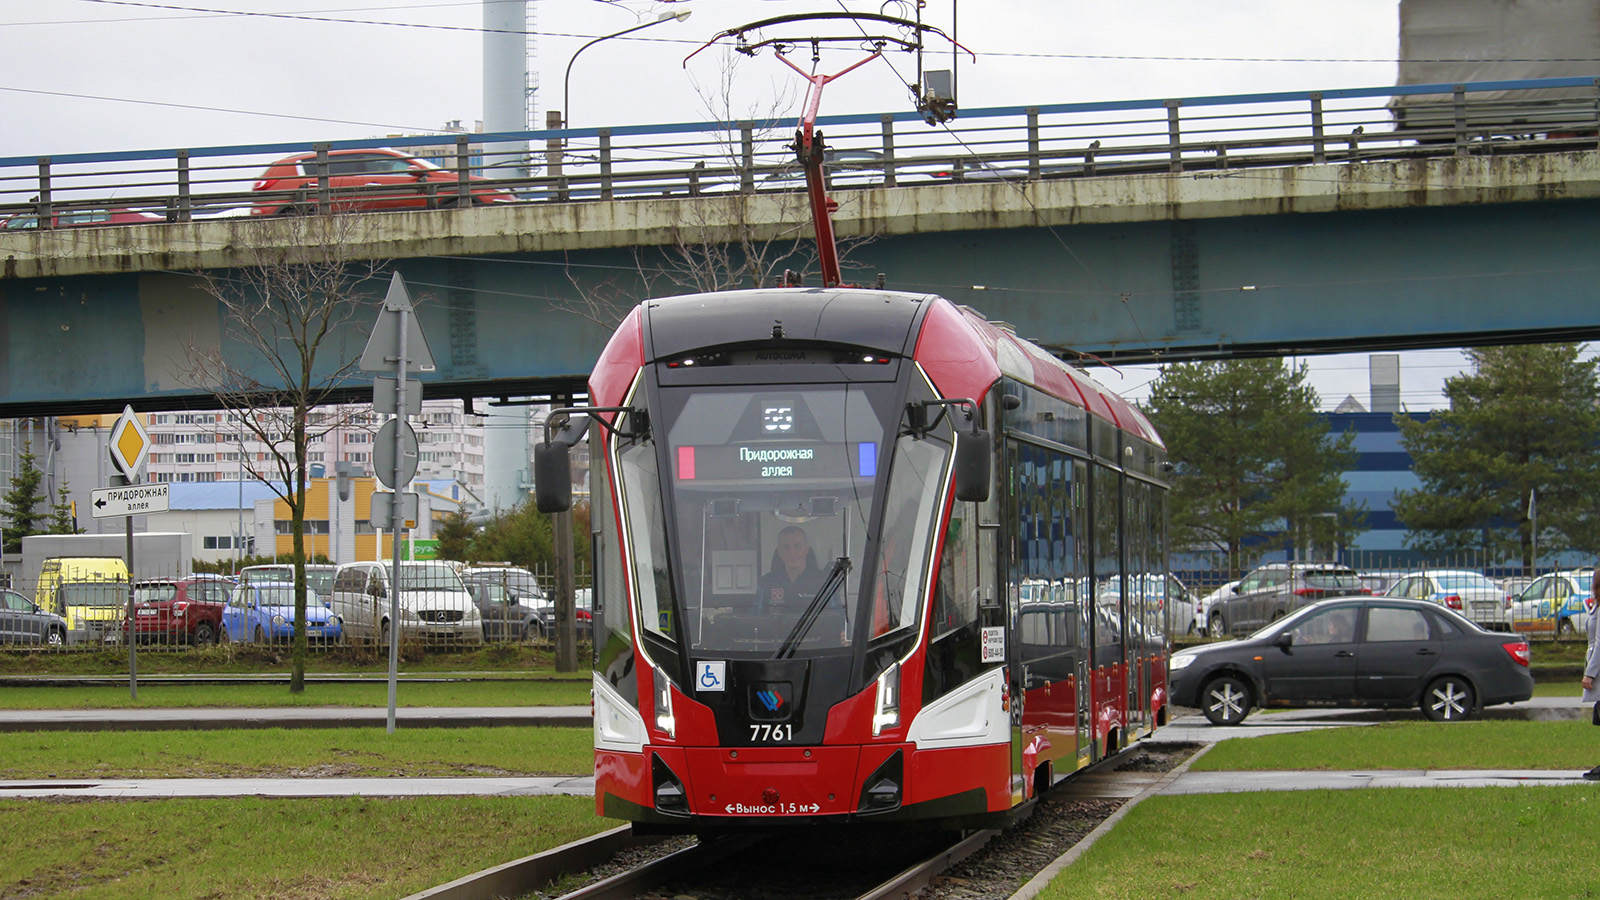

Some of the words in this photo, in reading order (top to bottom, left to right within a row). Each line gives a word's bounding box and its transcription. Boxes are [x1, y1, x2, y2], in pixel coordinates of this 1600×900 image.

[739, 447, 813, 462] Придорожная
[761, 466, 793, 477] аллея
[108, 487, 168, 501] ПРИДОРОЖНАЯ
[127, 502, 149, 511] аллея
[750, 724, 792, 742] 7761
[736, 803, 776, 813] Вынос
[780, 803, 796, 814] 1,5
[799, 805, 809, 813] м
